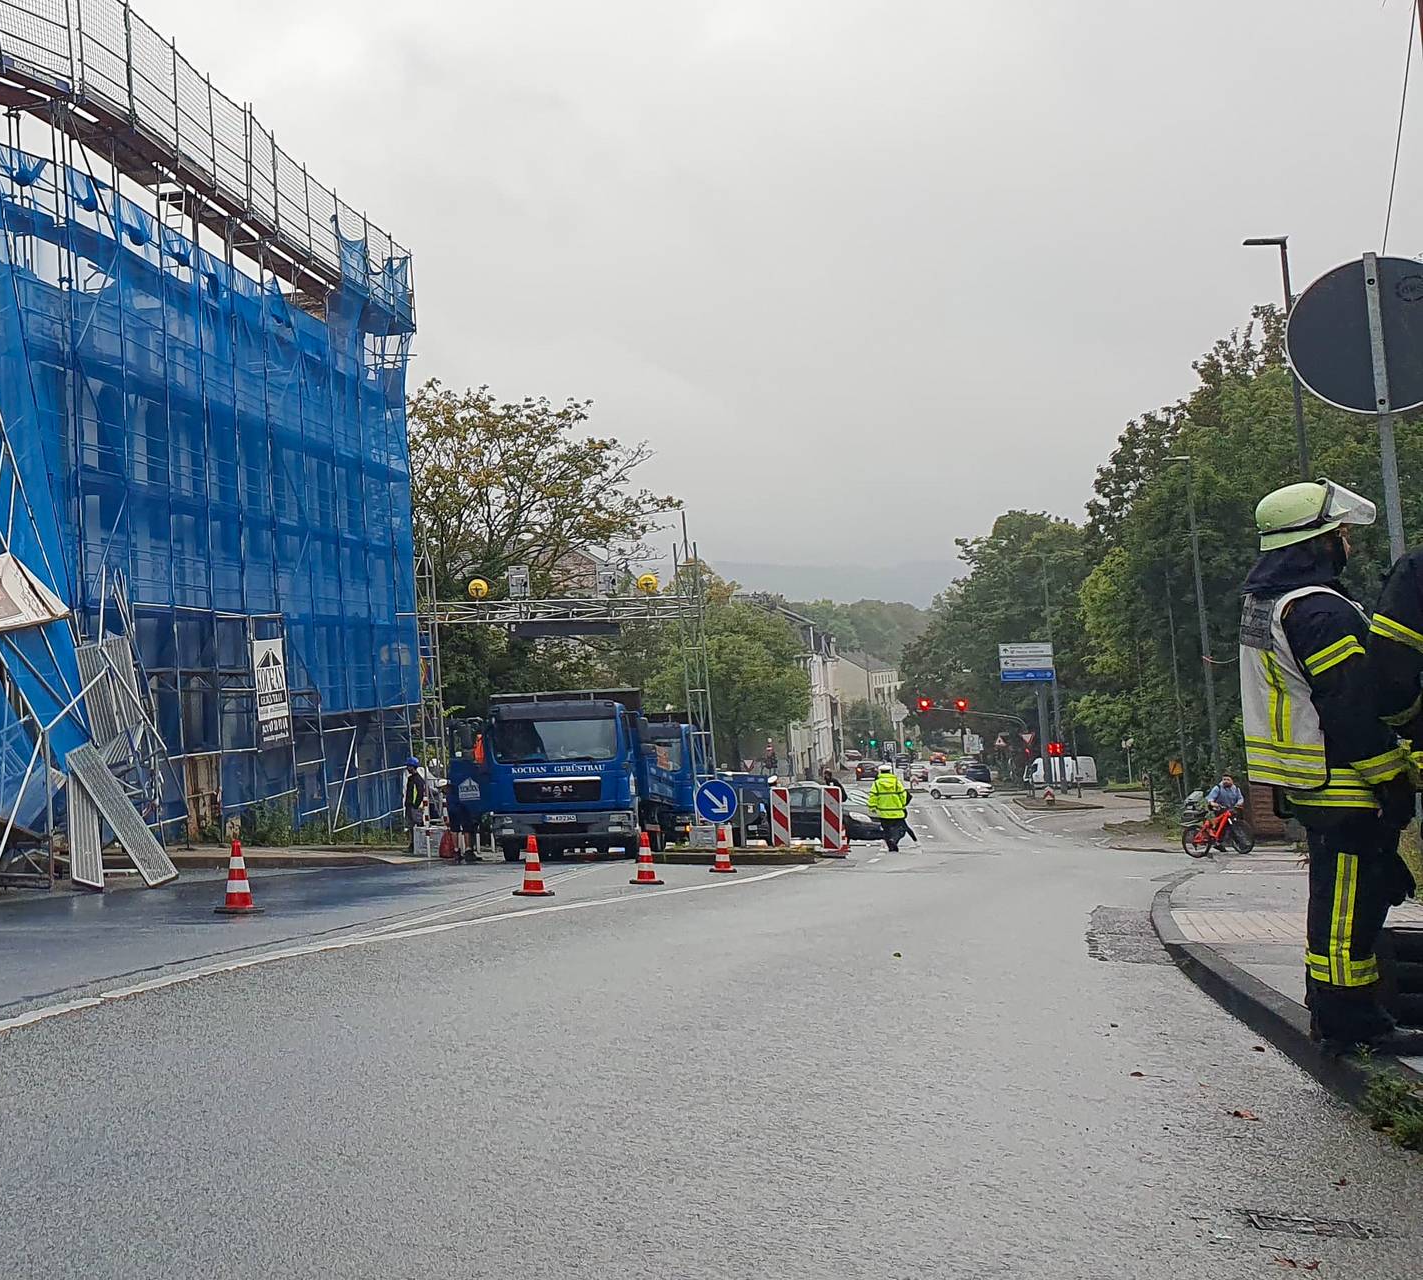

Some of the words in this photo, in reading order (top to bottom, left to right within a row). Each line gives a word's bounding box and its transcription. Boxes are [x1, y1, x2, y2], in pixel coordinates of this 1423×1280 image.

[511, 765, 547, 775] KOCHAN
[553, 763, 606, 773] GERÜSTBAU
[541, 785, 573, 793] MAN
